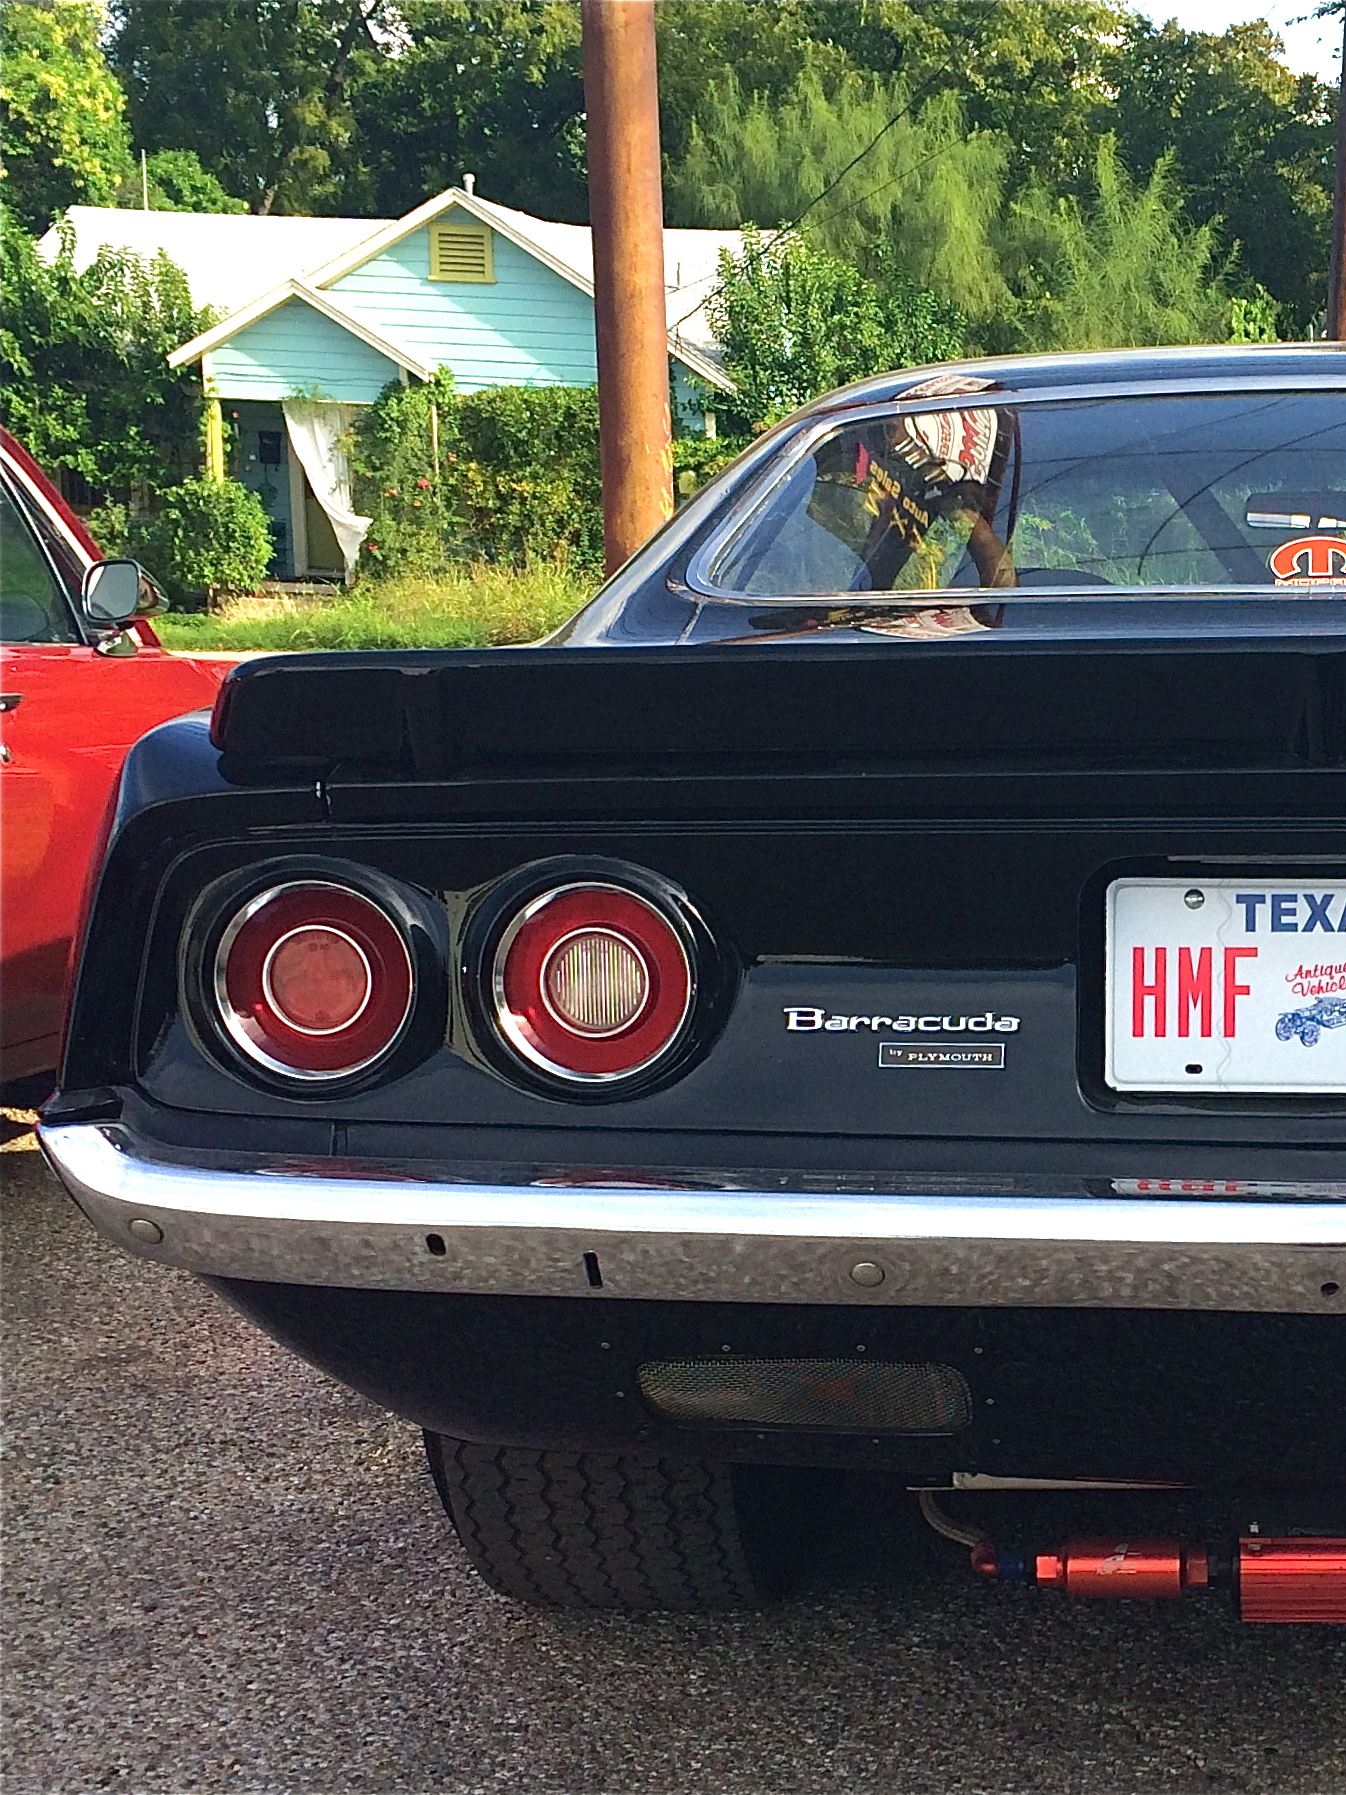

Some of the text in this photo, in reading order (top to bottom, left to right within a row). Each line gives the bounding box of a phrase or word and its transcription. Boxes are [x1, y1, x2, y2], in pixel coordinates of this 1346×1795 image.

[1132, 947, 1258, 1038] HMF
[783, 1007, 1021, 1032] Barracuda
[908, 1053, 993, 1062] PLYMOUTH
